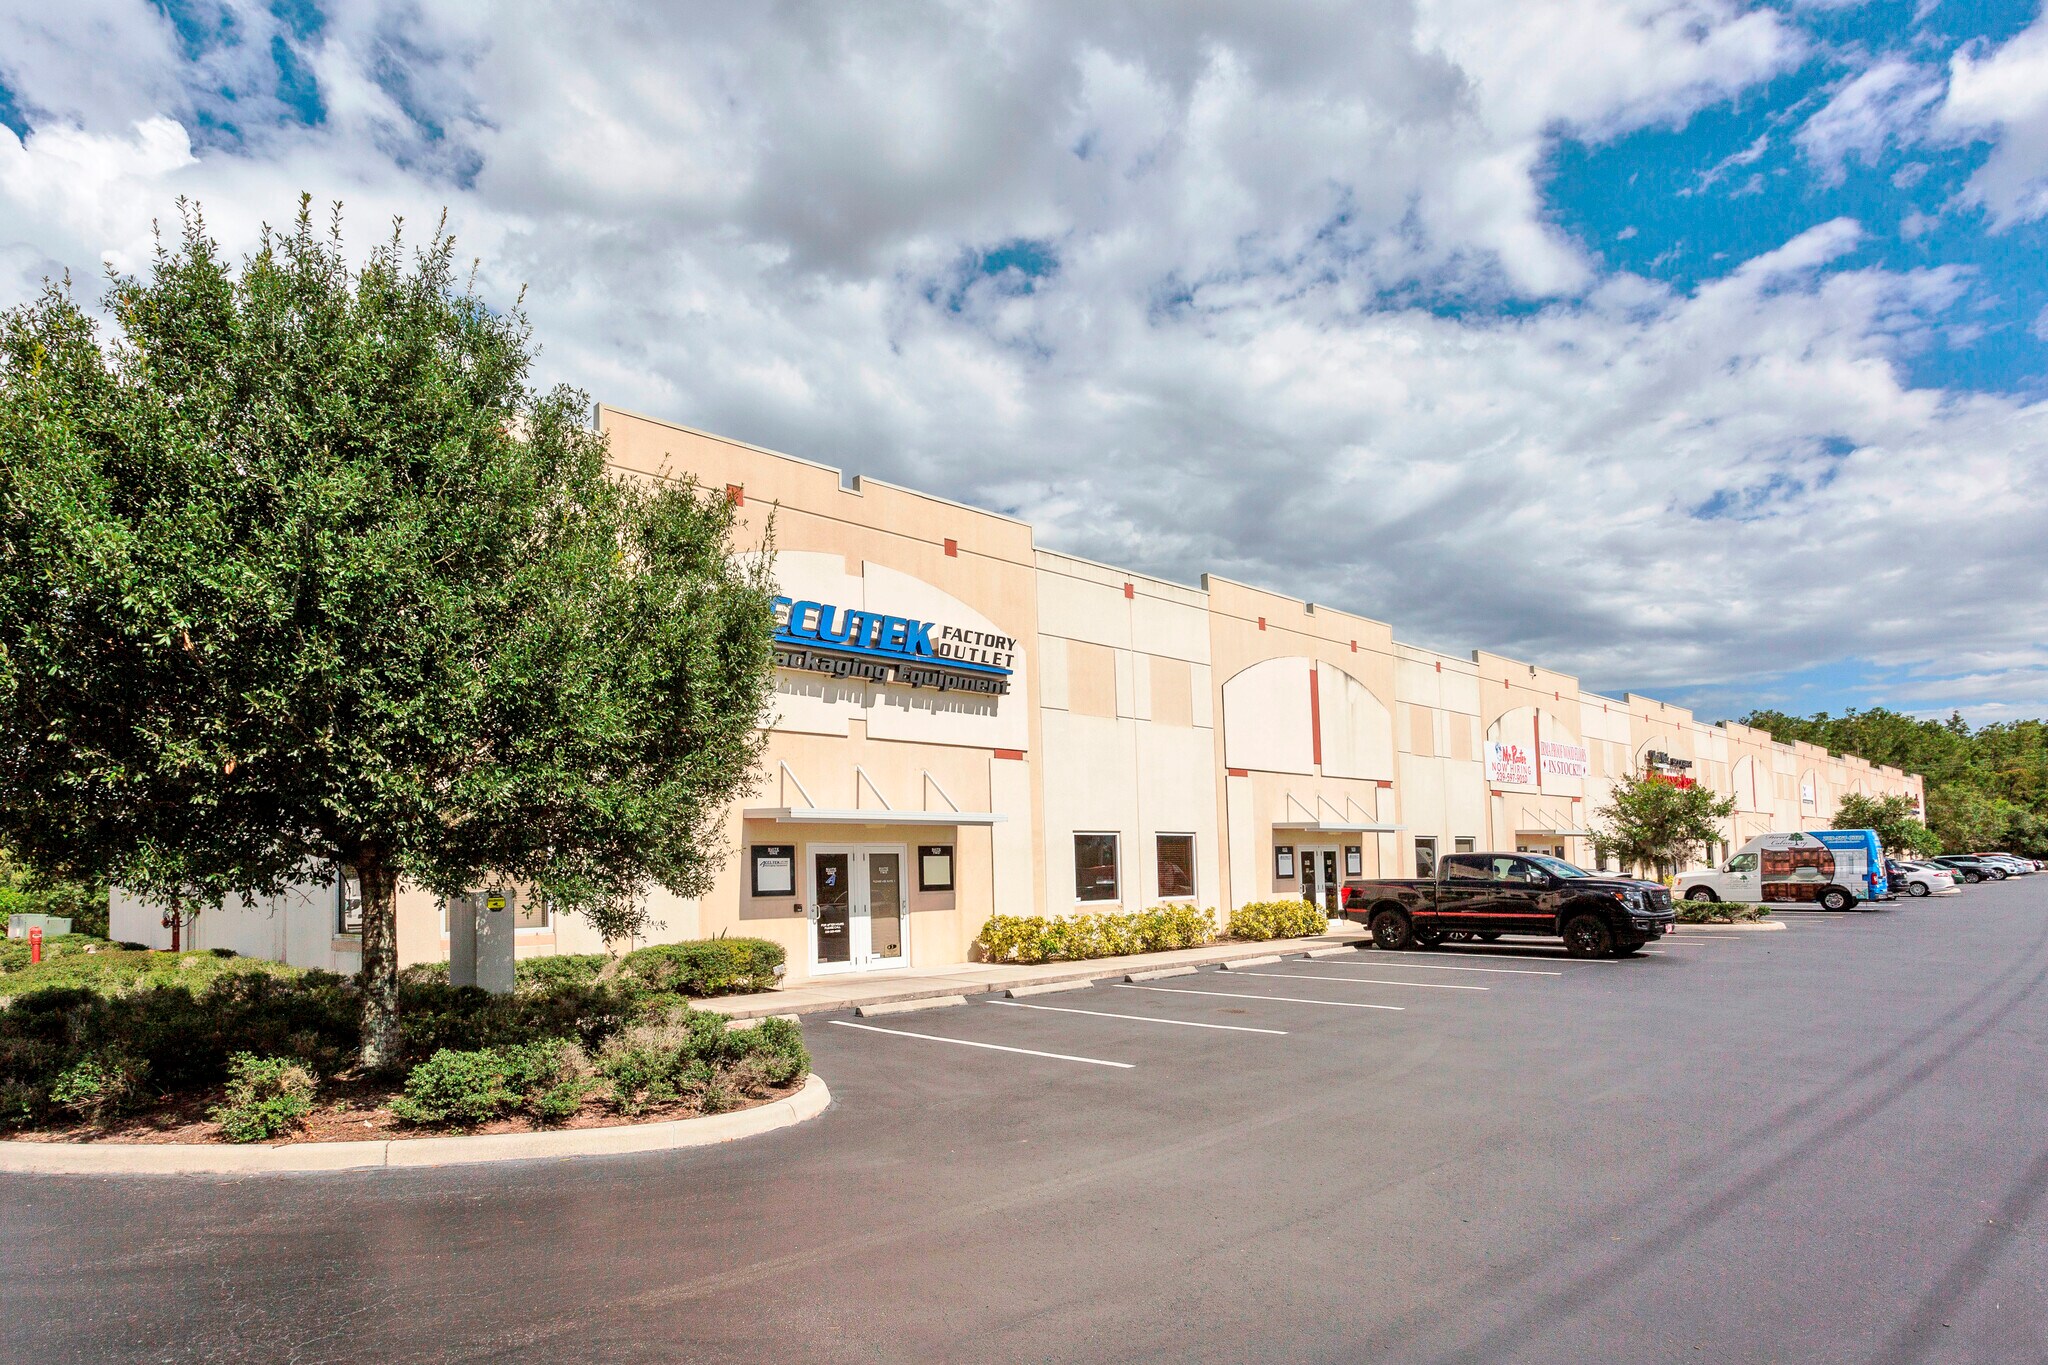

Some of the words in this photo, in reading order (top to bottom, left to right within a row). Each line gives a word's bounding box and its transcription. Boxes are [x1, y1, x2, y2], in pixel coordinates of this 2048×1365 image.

[769, 596, 936, 655] CCUTEK
[941, 625, 1017, 651] FACTORY
[940, 643, 1015, 667] OUTLET
[768, 650, 889, 684] ackaging
[897, 664, 1010, 695] Equipment
[1491, 761, 1508, 773] NOW
[1510, 764, 1532, 775] HIRING
[1549, 759, 1556, 773] IN
